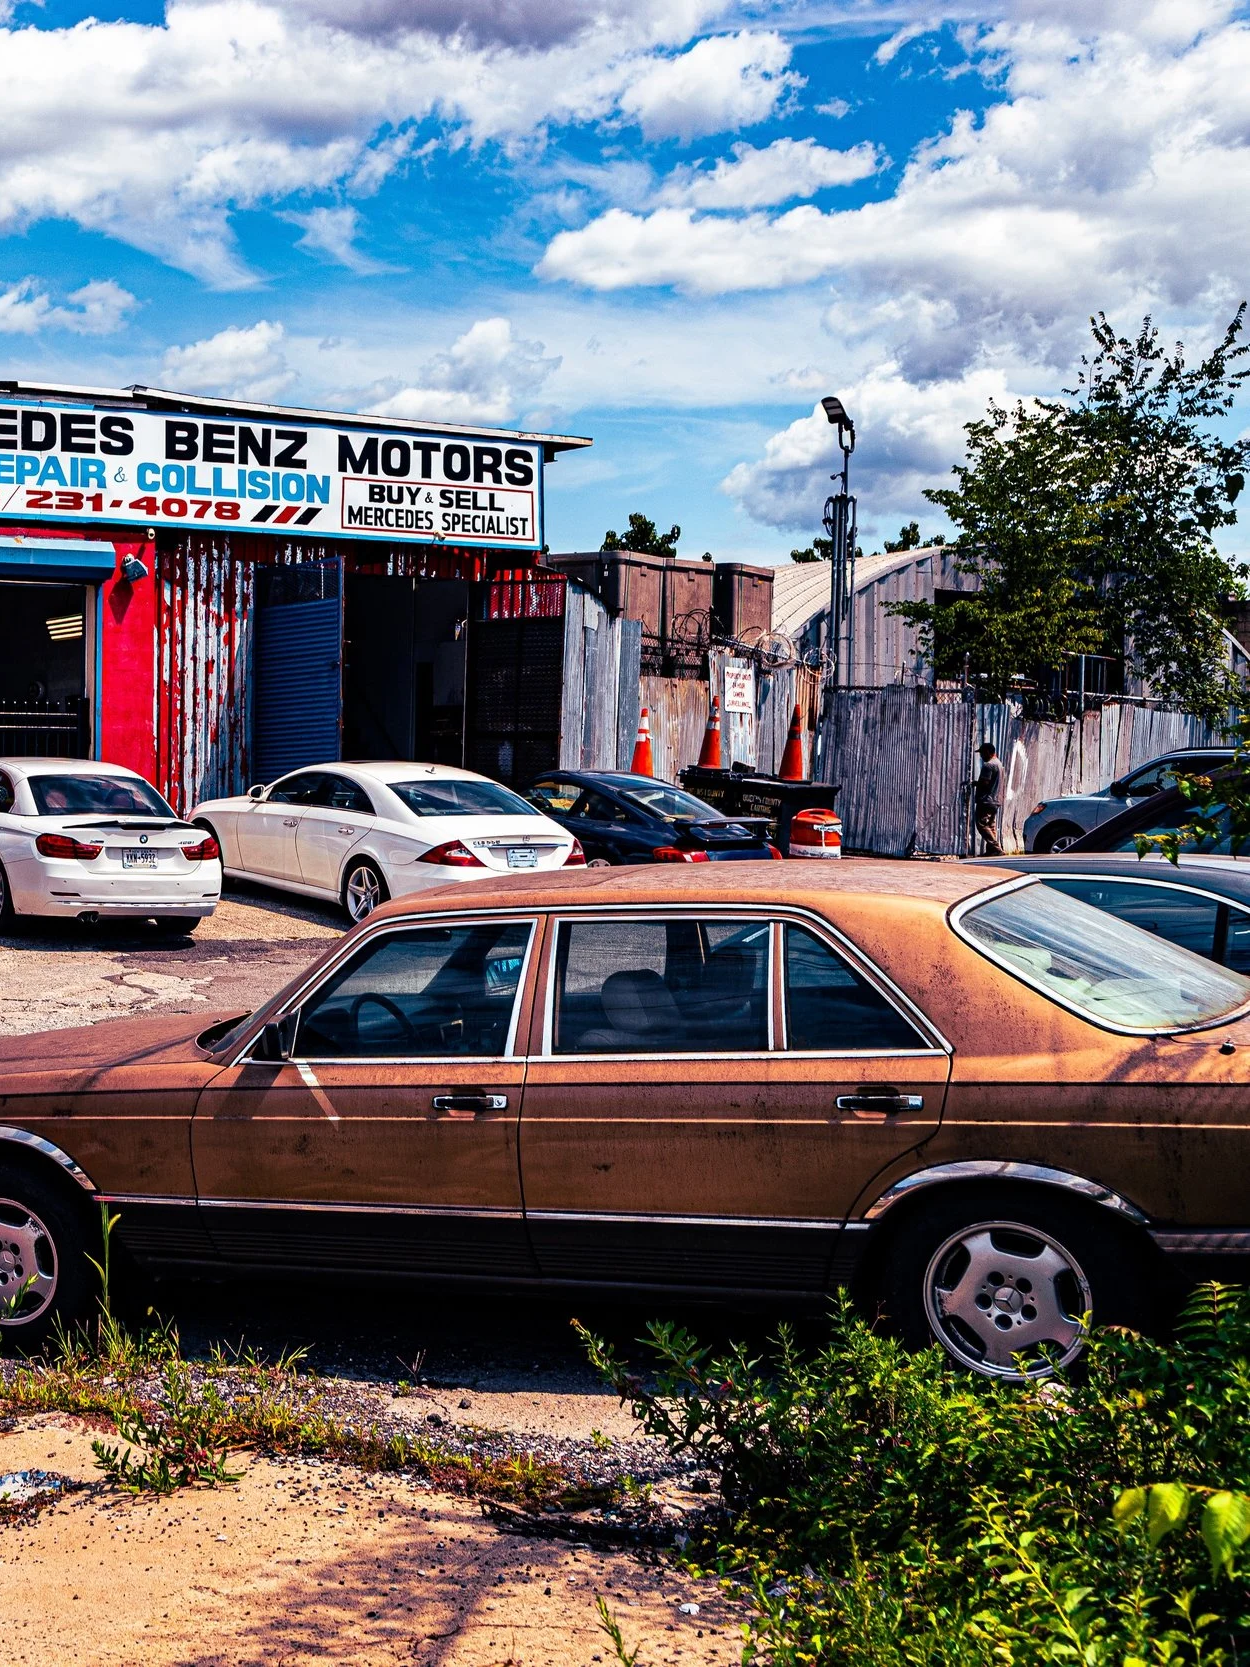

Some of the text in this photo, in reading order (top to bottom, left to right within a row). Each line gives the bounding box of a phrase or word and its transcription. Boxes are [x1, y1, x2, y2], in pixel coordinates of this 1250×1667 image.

[165, 419, 308, 470] BENZ
[337, 434, 534, 487] MOTORS
[113, 466, 129, 484] &
[136, 462, 331, 504] COLLISION
[368, 483, 505, 513] BUY & SELL
[347, 505, 529, 536] MERCEDES SPECIALIST
